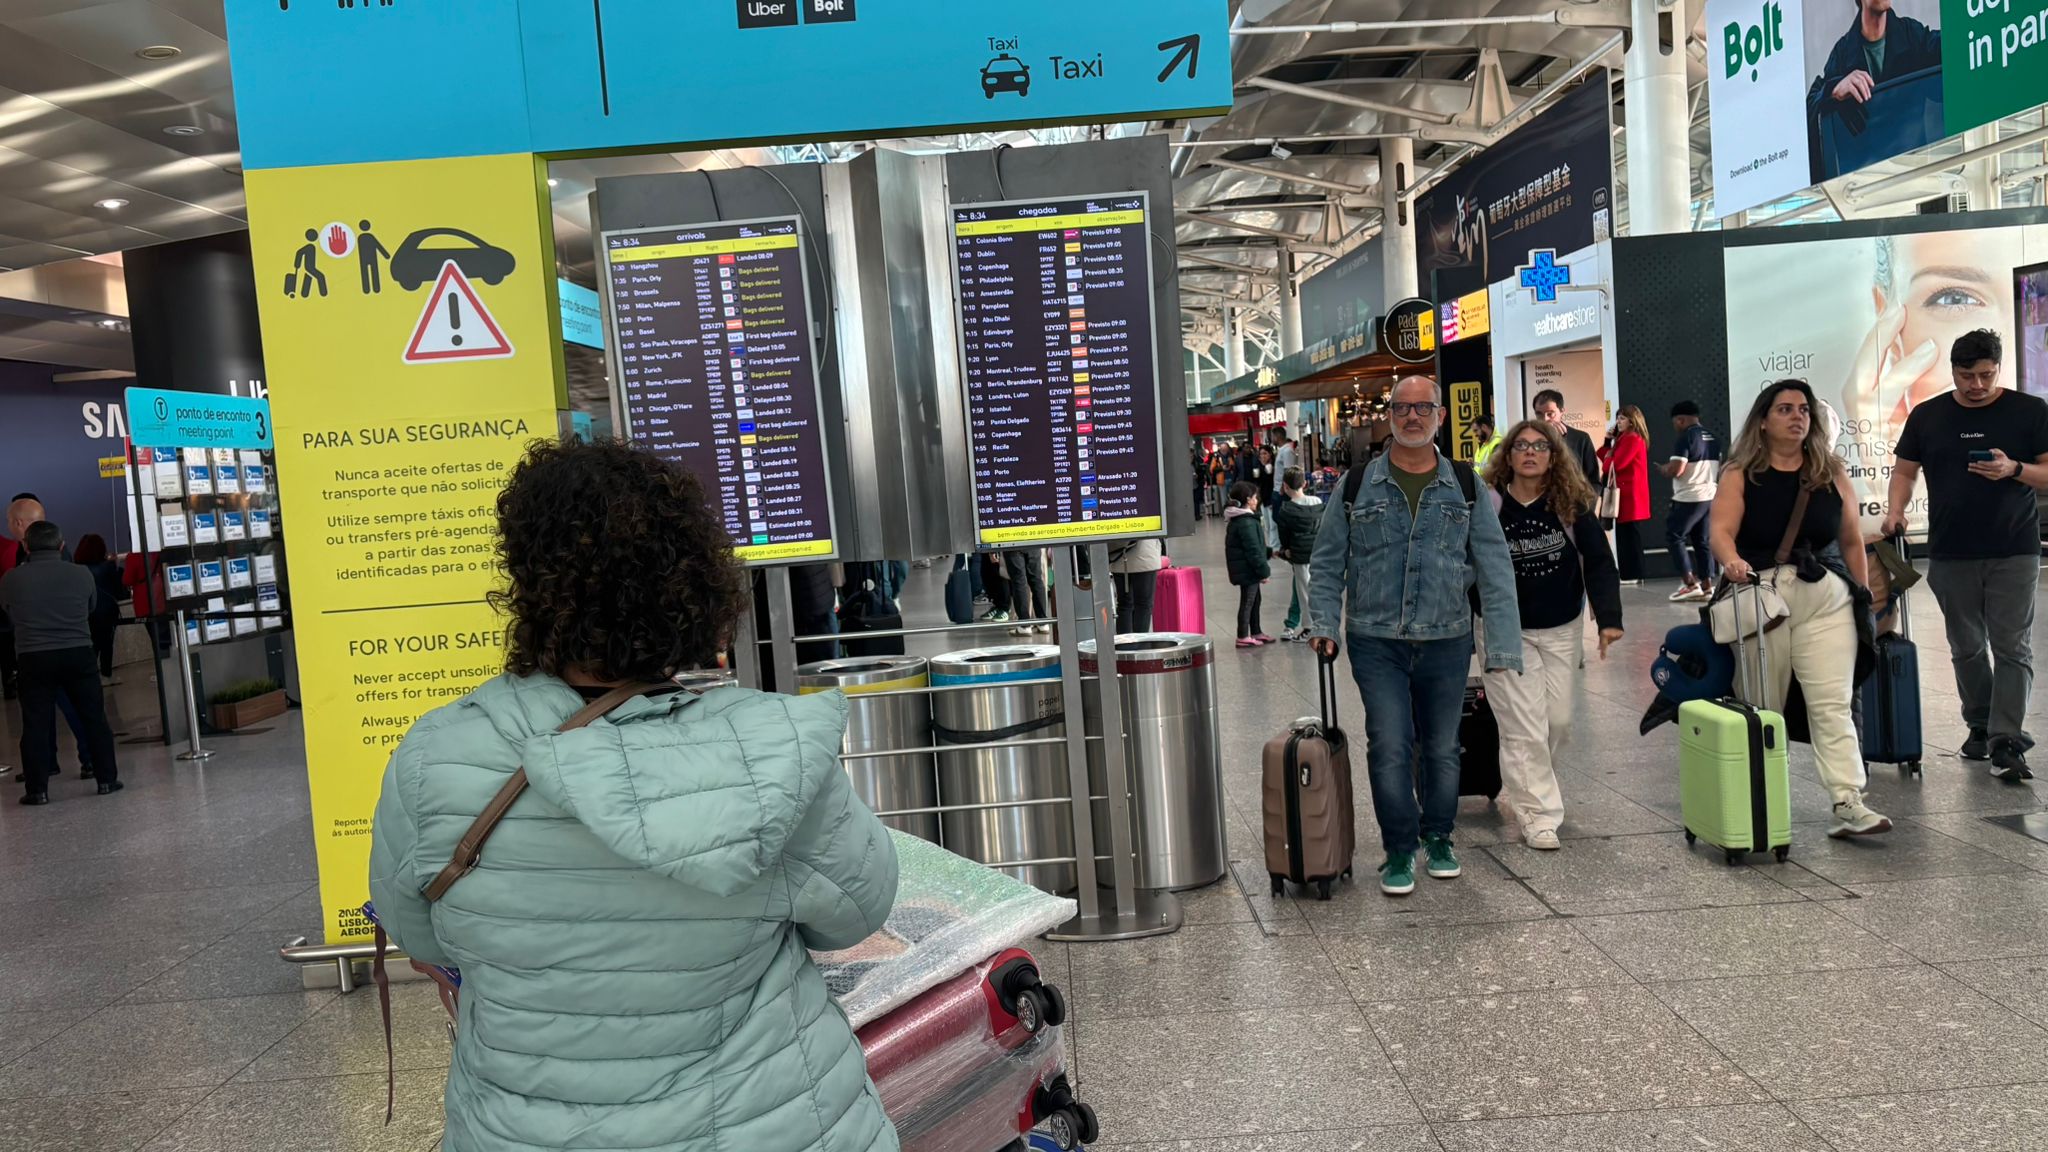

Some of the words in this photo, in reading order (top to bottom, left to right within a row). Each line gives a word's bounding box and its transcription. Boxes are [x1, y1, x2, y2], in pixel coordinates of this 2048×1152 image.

[748, 2, 786, 16] Uber
[814, 0, 844, 15] Bolt
[988, 36, 1018, 50] Taxi
[1724, 1, 1783, 82] Bolt
[1968, 30, 1993, 70] in
[1049, 54, 1104, 80] Taxi
[1730, 161, 1752, 178] Download
[1768, 152, 1778, 163] Bolt
[1779, 149, 1788, 160] app
[969, 211, 986, 220] 8:34
[1017, 206, 1058, 216] chegadas
[622, 237, 640, 247] 8:34
[675, 231, 706, 241] arrivals
[976, 250, 996, 258] Dublin
[977, 263, 1009, 271] Copenhaga
[978, 275, 1014, 284] Philadelphia
[632, 288, 659, 296] Brussels
[770, 329, 797, 338] delivered
[746, 344, 770, 353] Delayed
[643, 366, 662, 374] Zurich
[1758, 350, 1814, 375] viajar
[1114, 383, 1131, 391] 09:30
[646, 391, 667, 399] Madrid
[988, 405, 1012, 413] Istanbul
[1259, 407, 1287, 426] RELAY
[176, 408, 202, 422] ponto
[204, 408, 215, 420] de
[216, 410, 251, 422] encontro
[255, 412, 266, 440] 3
[178, 426, 213, 440] meeting
[214, 427, 234, 440] point
[303, 430, 354, 449] PARA
[359, 427, 400, 446] SUA
[406, 418, 528, 442] SEGURANÇA
[990, 430, 1022, 439] Copenhaga
[335, 470, 380, 481] Nunca
[384, 465, 427, 478] aceite
[431, 462, 482, 474] ofertas
[486, 460, 503, 471] de
[322, 486, 396, 501] transporte
[401, 484, 427, 497] que
[431, 481, 457, 492] não
[327, 515, 370, 527] Utilize
[374, 512, 427, 526] sempre
[432, 507, 464, 520] táxis
[326, 536, 344, 545] ou
[348, 530, 412, 544] transfers
[996, 530, 1028, 538] bem-vindo
[1036, 527, 1066, 535] aeroporto
[1065, 525, 1096, 533] Humberto
[1095, 523, 1120, 531] Delgado
[365, 551, 374, 560] a
[378, 547, 416, 562] partir
[421, 545, 446, 558] das
[450, 543, 490, 554] zonas
[336, 564, 427, 580] identificadas
[432, 563, 464, 576] para
[468, 561, 476, 570] o
[350, 639, 388, 656] FOR
[394, 634, 448, 653] YOUR
[354, 674, 393, 685] Never
[398, 668, 446, 682] accept
[356, 690, 398, 702] offers
[403, 687, 422, 698] for
[1039, 695, 1060, 708] papel
[361, 715, 409, 727] Always
[363, 736, 376, 745] or
[334, 818, 368, 827] Reporte
